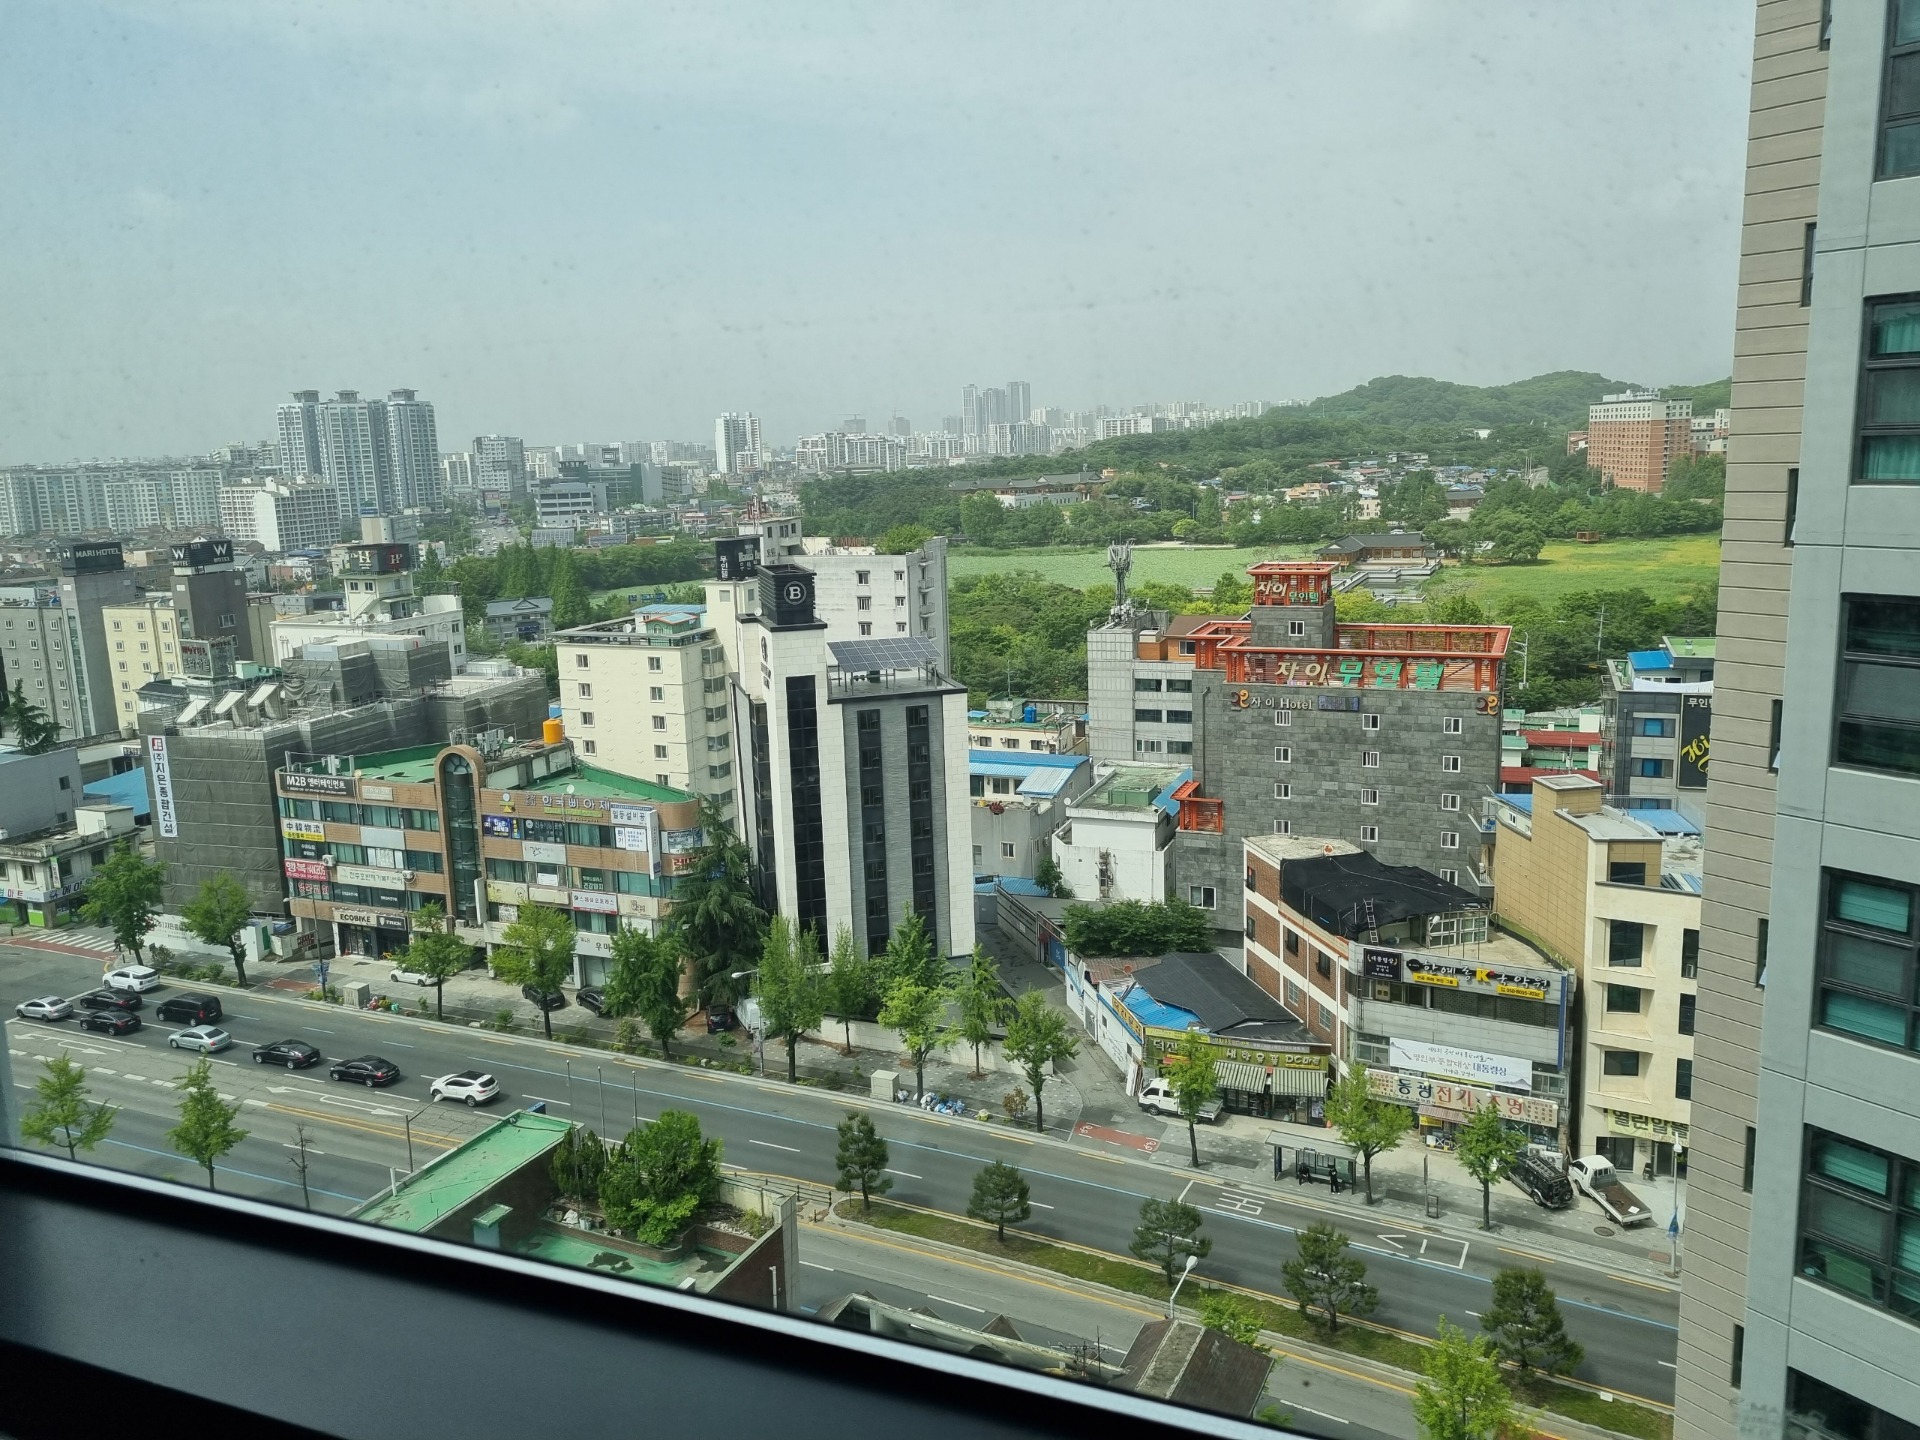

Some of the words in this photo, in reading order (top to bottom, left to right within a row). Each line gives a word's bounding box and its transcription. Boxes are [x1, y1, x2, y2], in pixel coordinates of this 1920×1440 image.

[75, 549, 96, 558] MARI
[95, 547, 121, 556] HOTEL
[172, 547, 185, 560] W
[213, 543, 227, 556] W
[789, 586, 801, 600] B
[1257, 580, 1288, 597] 자이
[1289, 591, 1319, 603] 무인텔
[1335, 661, 1444, 690] 무인텔
[1250, 696, 1276, 709] 자이
[1280, 697, 1313, 711] Hotel
[286, 775, 307, 787] M2B
[307, 777, 346, 789] 엔터테인먼트
[153, 753, 173, 834] (주)지은종합건설
[286, 822, 322, 834] 中韓物流
[340, 913, 371, 923] ECOBIKE
[1476, 967, 1490, 983] K
[1497, 973, 1548, 991] 국악원
[1473, 1062, 1507, 1077] 대통령상
[1436, 1084, 1472, 1107] 전기
